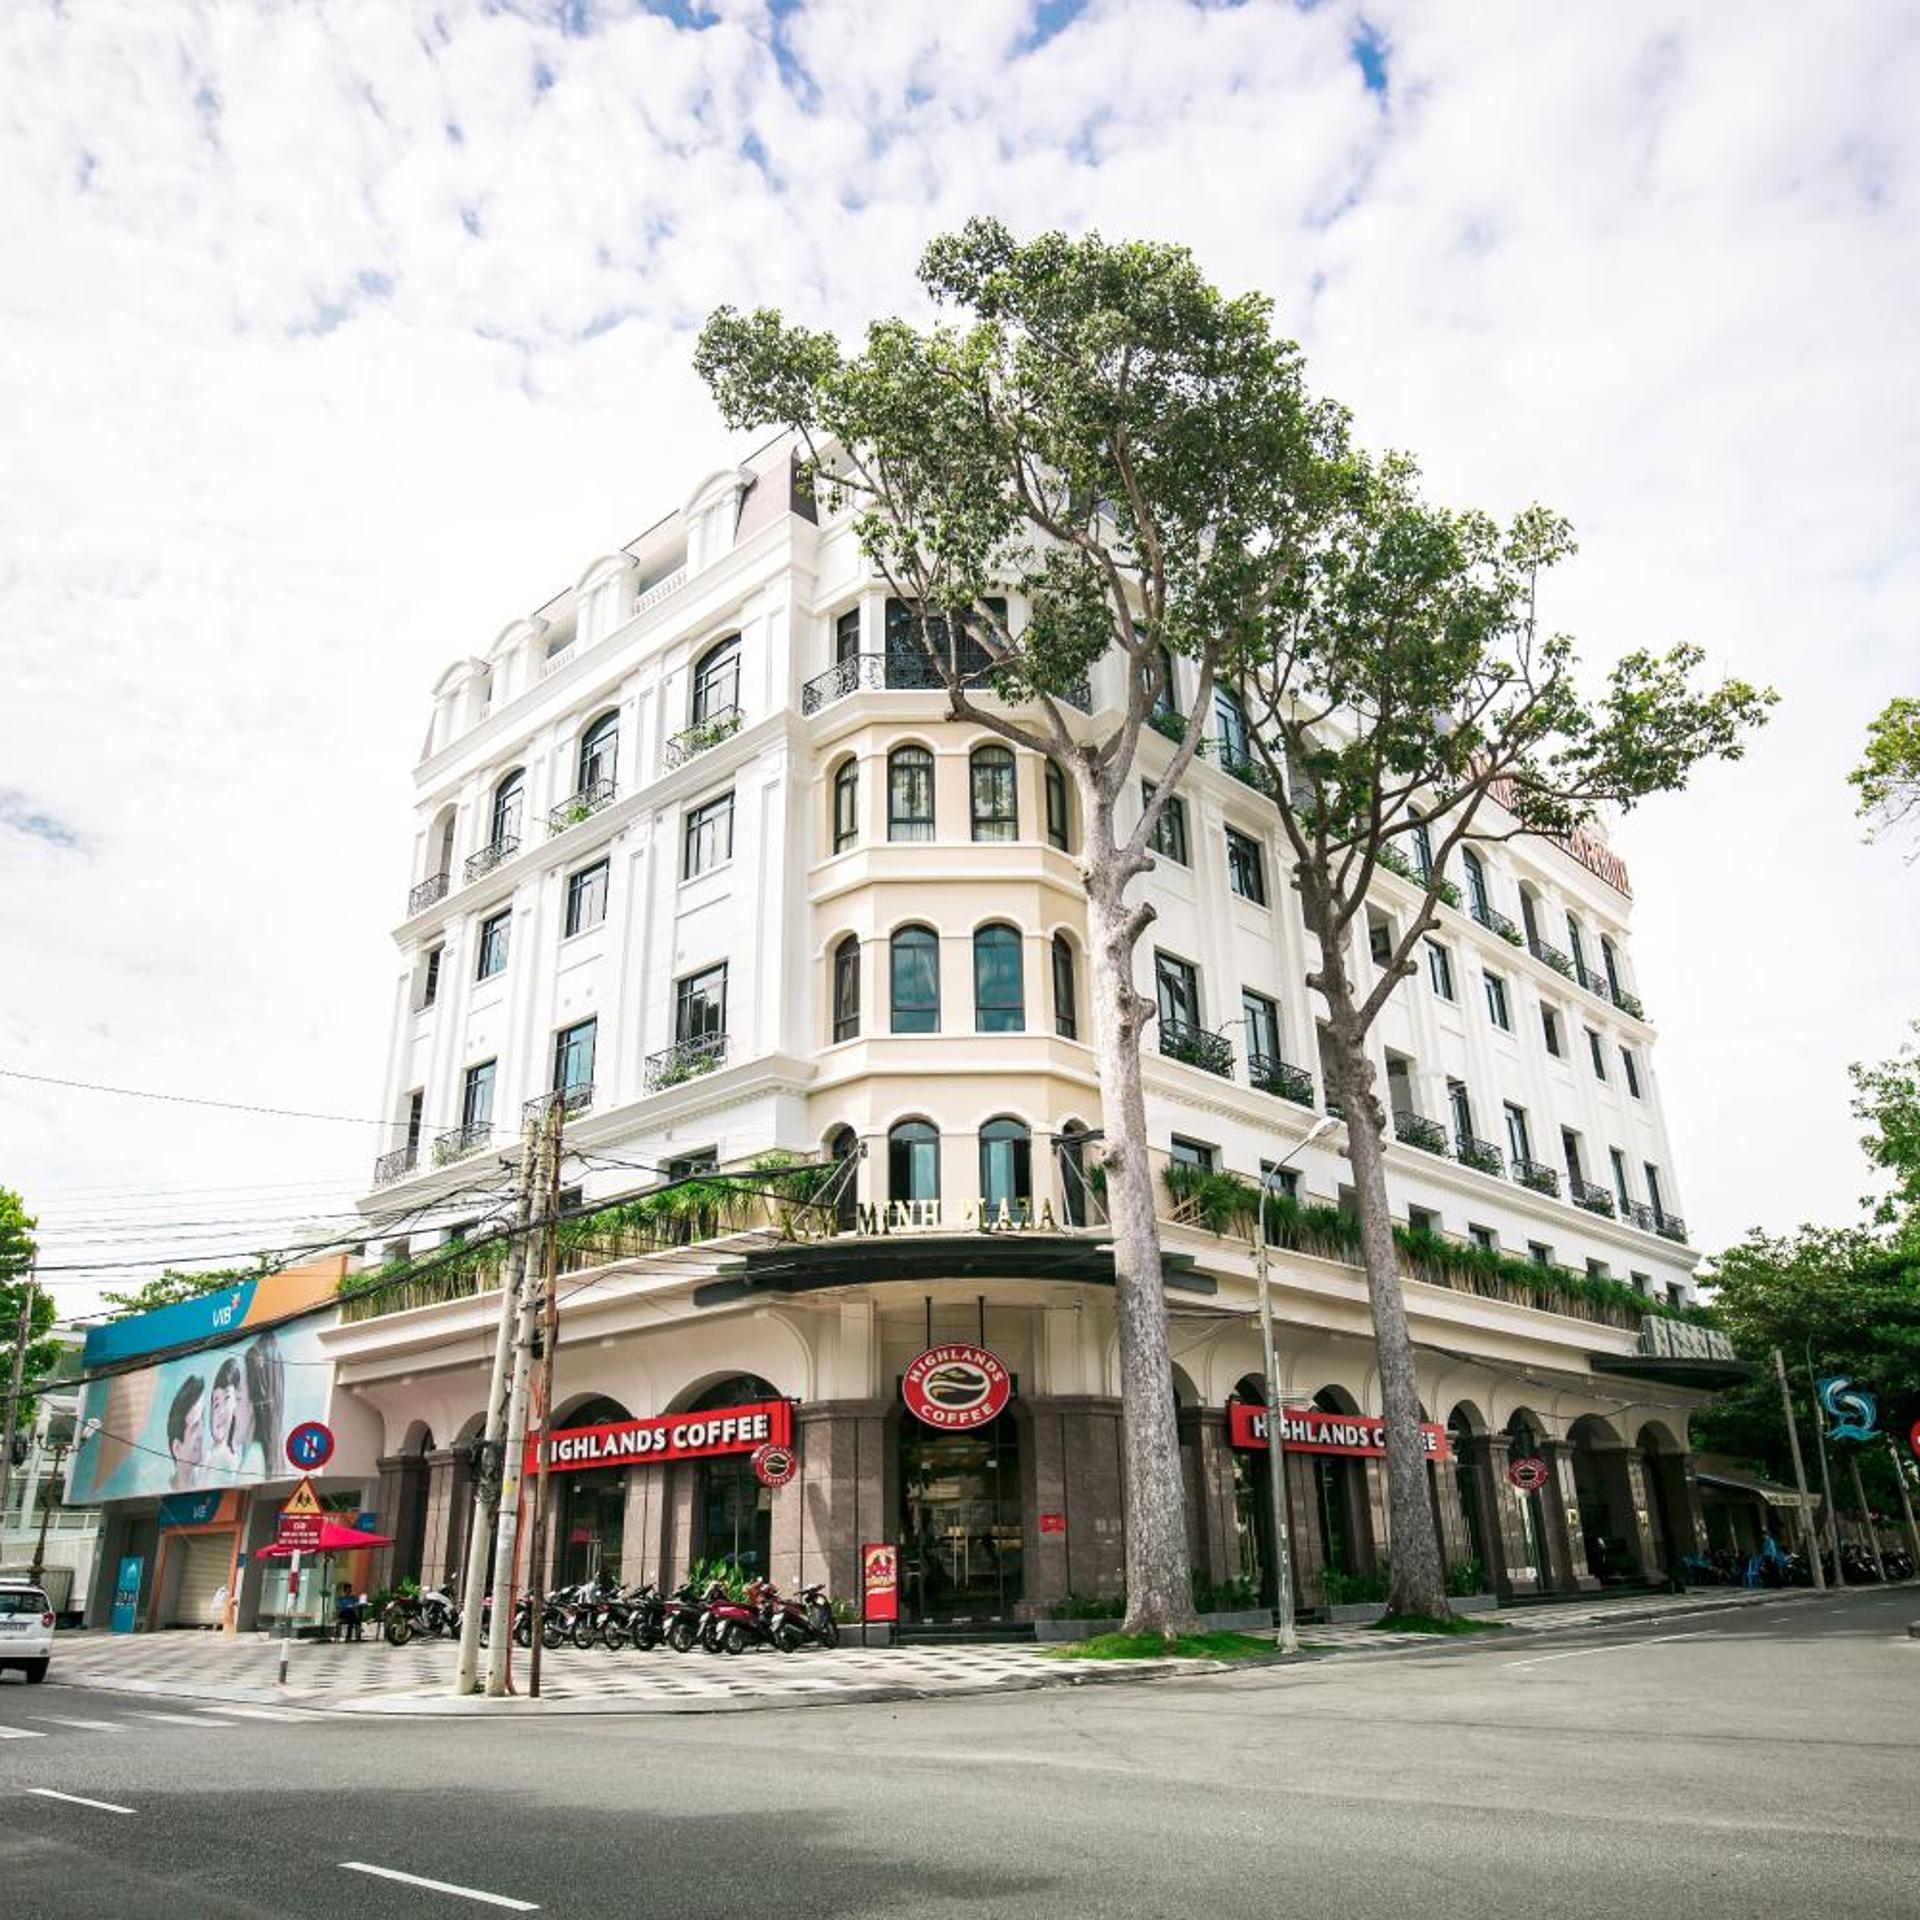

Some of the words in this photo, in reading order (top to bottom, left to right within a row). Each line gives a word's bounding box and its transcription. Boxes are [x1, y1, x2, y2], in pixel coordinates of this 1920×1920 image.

[857, 1200, 941, 1235] MINH
[963, 1198, 1058, 1232] PLAZA
[212, 1306, 231, 1328] VIB
[909, 1350, 1004, 1383] HIGHLANDS
[921, 1403, 993, 1424] COFFEE
[672, 1414, 768, 1448] COFFEE
[1253, 1414, 1369, 1447] HGHLANDS
